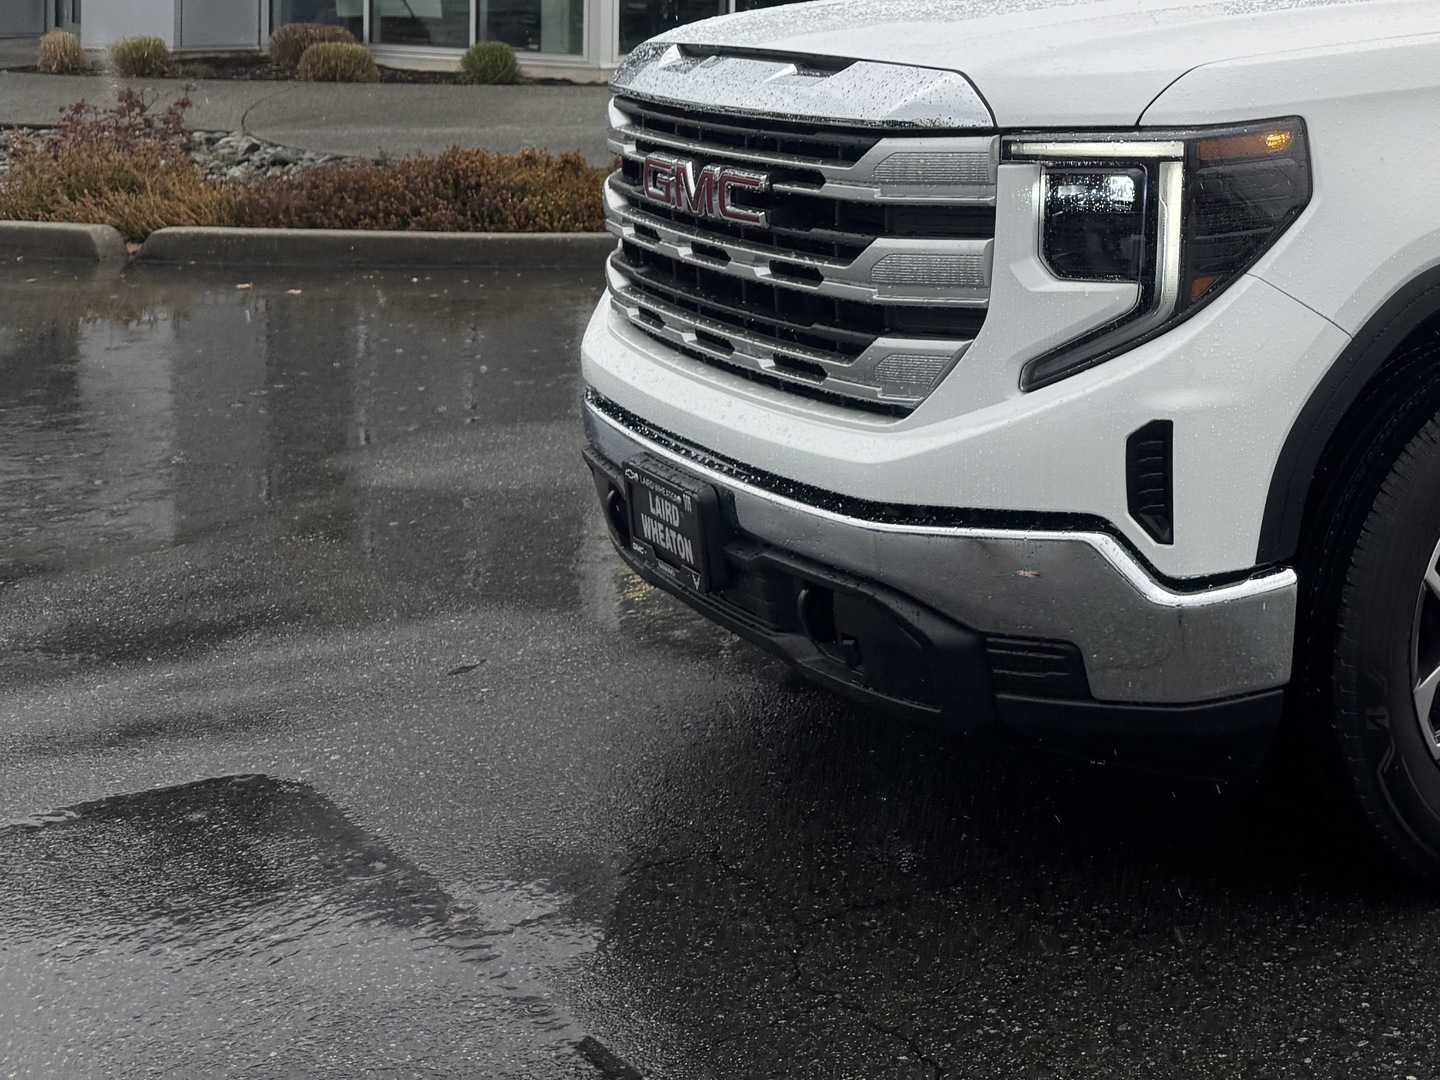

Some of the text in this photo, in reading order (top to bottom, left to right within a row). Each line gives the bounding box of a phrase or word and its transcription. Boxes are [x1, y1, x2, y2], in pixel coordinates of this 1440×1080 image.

[643, 152, 769, 228] GMC
[649, 491, 680, 528] LAIRD
[641, 513, 694, 565] WHEATON
